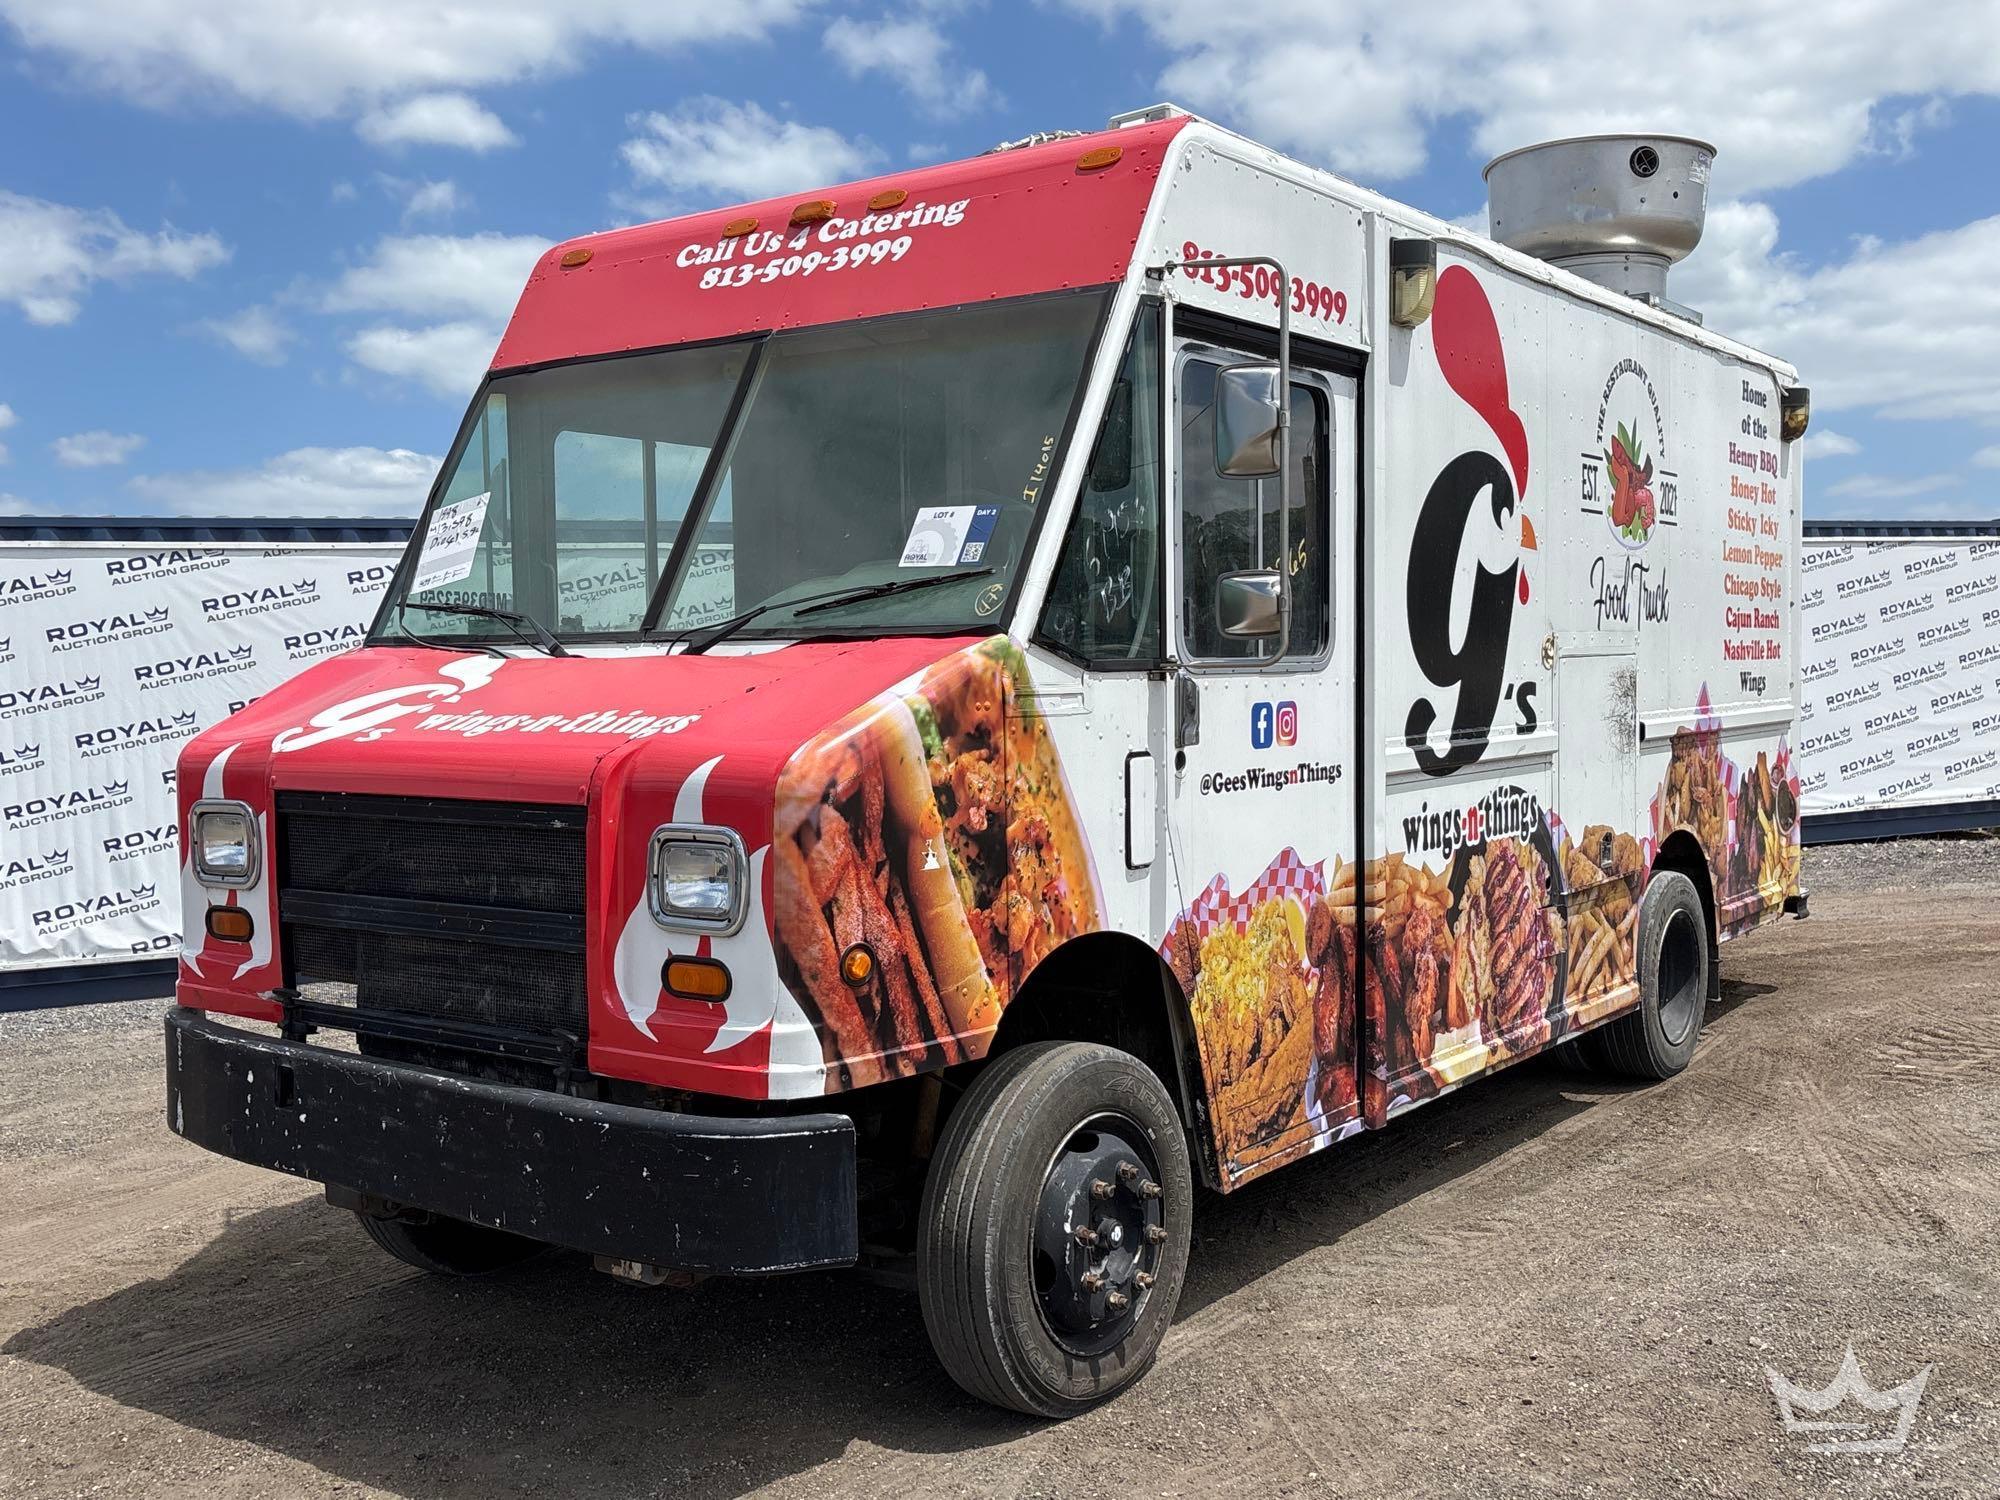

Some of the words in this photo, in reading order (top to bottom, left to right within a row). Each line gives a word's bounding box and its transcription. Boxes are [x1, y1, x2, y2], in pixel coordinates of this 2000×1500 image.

[676, 236, 740, 268] Call
[743, 231, 784, 257] Us
[788, 226, 811, 251] 4
[817, 199, 970, 244] Catering
[699, 235, 913, 290] 813-509-3999
[1741, 379, 1767, 409] Home
[1596, 400, 1606, 444] THE
[1602, 358, 1648, 403] RESTAURANT
[1646, 381, 1666, 459] QUALITY
[1741, 418, 1751, 435] of
[1752, 417, 1767, 440] the
[1728, 442, 1757, 474] Henny
[1759, 449, 1778, 479] BBQ
[1659, 481, 1678, 517] 2021
[1730, 475, 1759, 505] Honey
[1760, 482, 1777, 506] Hot
[933, 511, 948, 519] LOT
[1727, 507, 1757, 536] Sticky
[1760, 513, 1779, 541] Icky
[106, 549, 203, 576] ROYAL
[690, 551, 734, 568] ROY
[904, 553, 928, 561] ROYAL
[1722, 540, 1752, 566] Lemon
[1753, 550, 1783, 576] Pepper
[1904, 555, 1946, 574] ROYAL
[111, 567, 177, 586] AUCTION
[180, 558, 231, 573] GROUP
[347, 563, 399, 585] ROY
[559, 568, 639, 594] ROYAL
[1906, 568, 1935, 581] AUCTION
[1935, 561, 1959, 572] GROUP
[21, 585, 77, 603] GROUP
[352, 580, 389, 595] AUCT
[620, 581, 645, 593] GRO
[1589, 554, 1631, 632] Food
[1630, 558, 1670, 632] Truck
[1723, 573, 1759, 602] Chicago
[1760, 577, 1782, 602] Style
[1837, 573, 1880, 593] ROYAL
[1839, 587, 1869, 600] AUCTION
[1869, 580, 1893, 591] GROUP
[1945, 579, 1987, 597] ROYAL
[1948, 592, 1976, 604] AUCTION
[1976, 584, 1999, 596] GROUP
[201, 585, 295, 613] ROYAL
[206, 604, 270, 623] AUCTION
[272, 594, 321, 611] GROUP
[1879, 598, 1922, 617] ROYAL
[673, 601, 714, 620] YAL
[1725, 606, 1752, 634] Cajun
[1753, 608, 1780, 630] Ranch
[1882, 611, 1911, 624] AUCTION
[1911, 603, 1935, 615] GROUP
[45, 613, 146, 643] ROYAL
[51, 633, 120, 653] AUCTION
[122, 623, 174, 640] GROUP
[1811, 617, 1856, 637] ROYAL
[1814, 630, 1844, 643] AUCTION
[1844, 623, 1868, 634] GROUP
[1917, 622, 1959, 641] ROYAL
[1919, 635, 1948, 648] AUCTION
[1948, 628, 1972, 639] GROUP
[288, 641, 350, 660] AUCTION
[1723, 639, 1765, 662] Nashville
[1765, 641, 1781, 661] Hot
[1850, 642, 1894, 662] ROYAL
[1853, 655, 1882, 668] AUCTION
[1882, 648, 1906, 659] GROUP
[1958, 645, 1999, 664] ROYAL
[134, 651, 229, 681] ROYAL
[139, 671, 204, 691] AUCTION
[207, 660, 257, 677] GROUP
[1801, 662, 1826, 677] YAL
[1815, 668, 1839, 680] GROUP
[1893, 665, 1935, 685] ROYAL
[1961, 658, 1989, 671] AUCTION
[1740, 671, 1767, 697] Wings
[1895, 679, 1924, 692] AUCTION
[1924, 670, 1948, 682] GROUP
[0, 682, 77, 709] OYAL
[1, 703, 49, 719] CTION
[51, 691, 106, 709] GROUP
[1825, 686, 1869, 706] ROYAL
[1828, 699, 1858, 713] AUCTION
[1858, 691, 1882, 703] GROUP
[1930, 688, 1972, 709] ROYAL
[1933, 702, 1961, 715] AUCTION
[1961, 694, 1985, 706] GROUP
[1864, 710, 1907, 730] ROYAL
[1867, 724, 1896, 737] AUCTION
[1896, 715, 1920, 727] GROUP
[75, 718, 173, 748] ROYAL
[1906, 732, 1949, 752] ROYAL
[80, 737, 147, 759] AUCTION
[1909, 745, 1938, 759] AUCTION
[1938, 737, 1961, 749] GROUP
[1, 760, 45, 776] ROUP
[1840, 753, 1883, 775] ROYAL
[1842, 768, 1872, 782] AUCTION
[1872, 759, 1896, 771] GROUP
[1944, 755, 1986, 775] ROYAL
[1946, 768, 1975, 782] AUCTION
[1975, 760, 1998, 772] GROUP
[1199, 761, 1343, 797] @GeesWingsnThings
[1878, 777, 1921, 798] ROYAL
[3, 788, 105, 820] ROYAL
[9, 808, 78, 831] AUCTION
[80, 796, 134, 814] GROUP
[103, 824, 178, 853] ROYA
[108, 841, 174, 863] AUCTION
[19, 865, 74, 884] GROUP
[32, 892, 133, 926] ROYAL
[38, 913, 106, 936] AUCTION
[109, 899, 161, 918] GROUP
